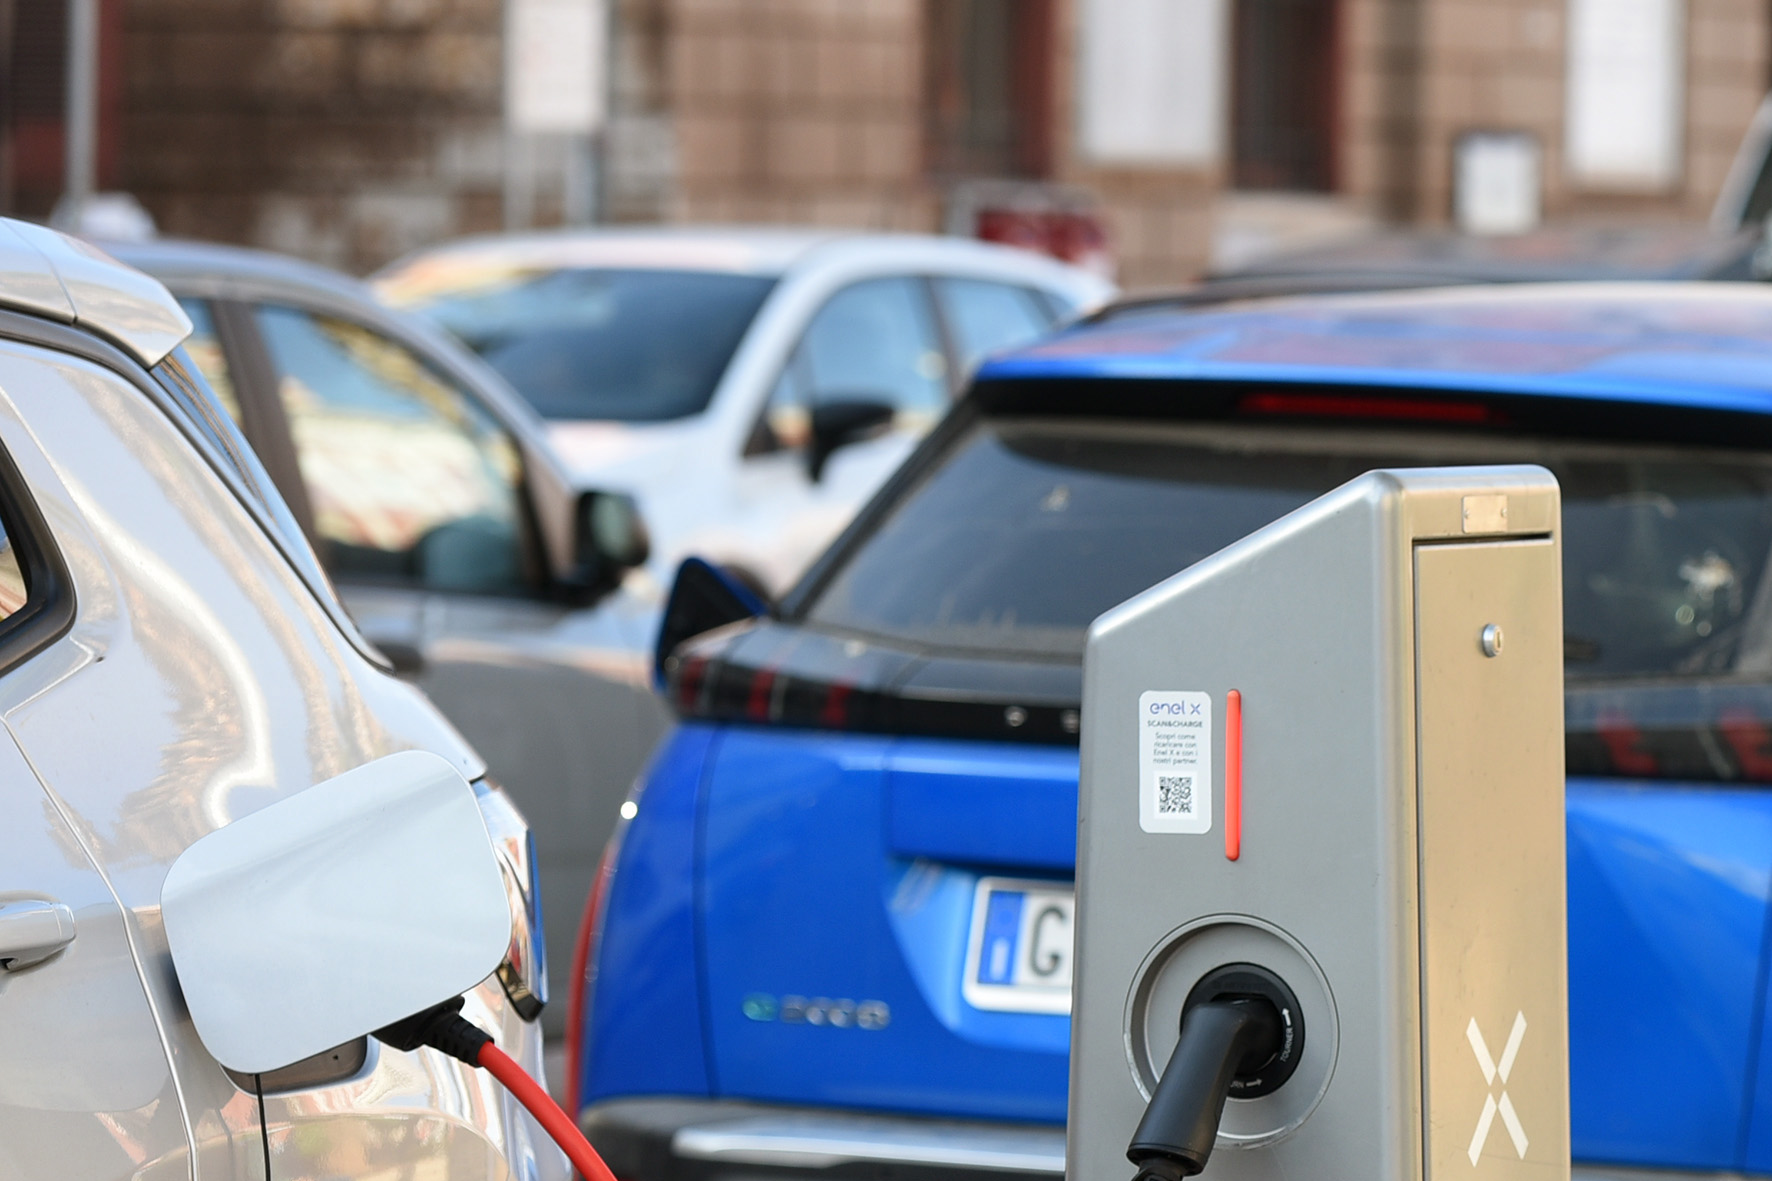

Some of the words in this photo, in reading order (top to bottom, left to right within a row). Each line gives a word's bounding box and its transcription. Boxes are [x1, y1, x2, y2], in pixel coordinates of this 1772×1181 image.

[1149, 699, 1186, 715] enel
[1190, 703, 1201, 715] x
[1280, 1027, 1294, 1063] TOURNER
[1465, 1009, 1529, 1168] x
